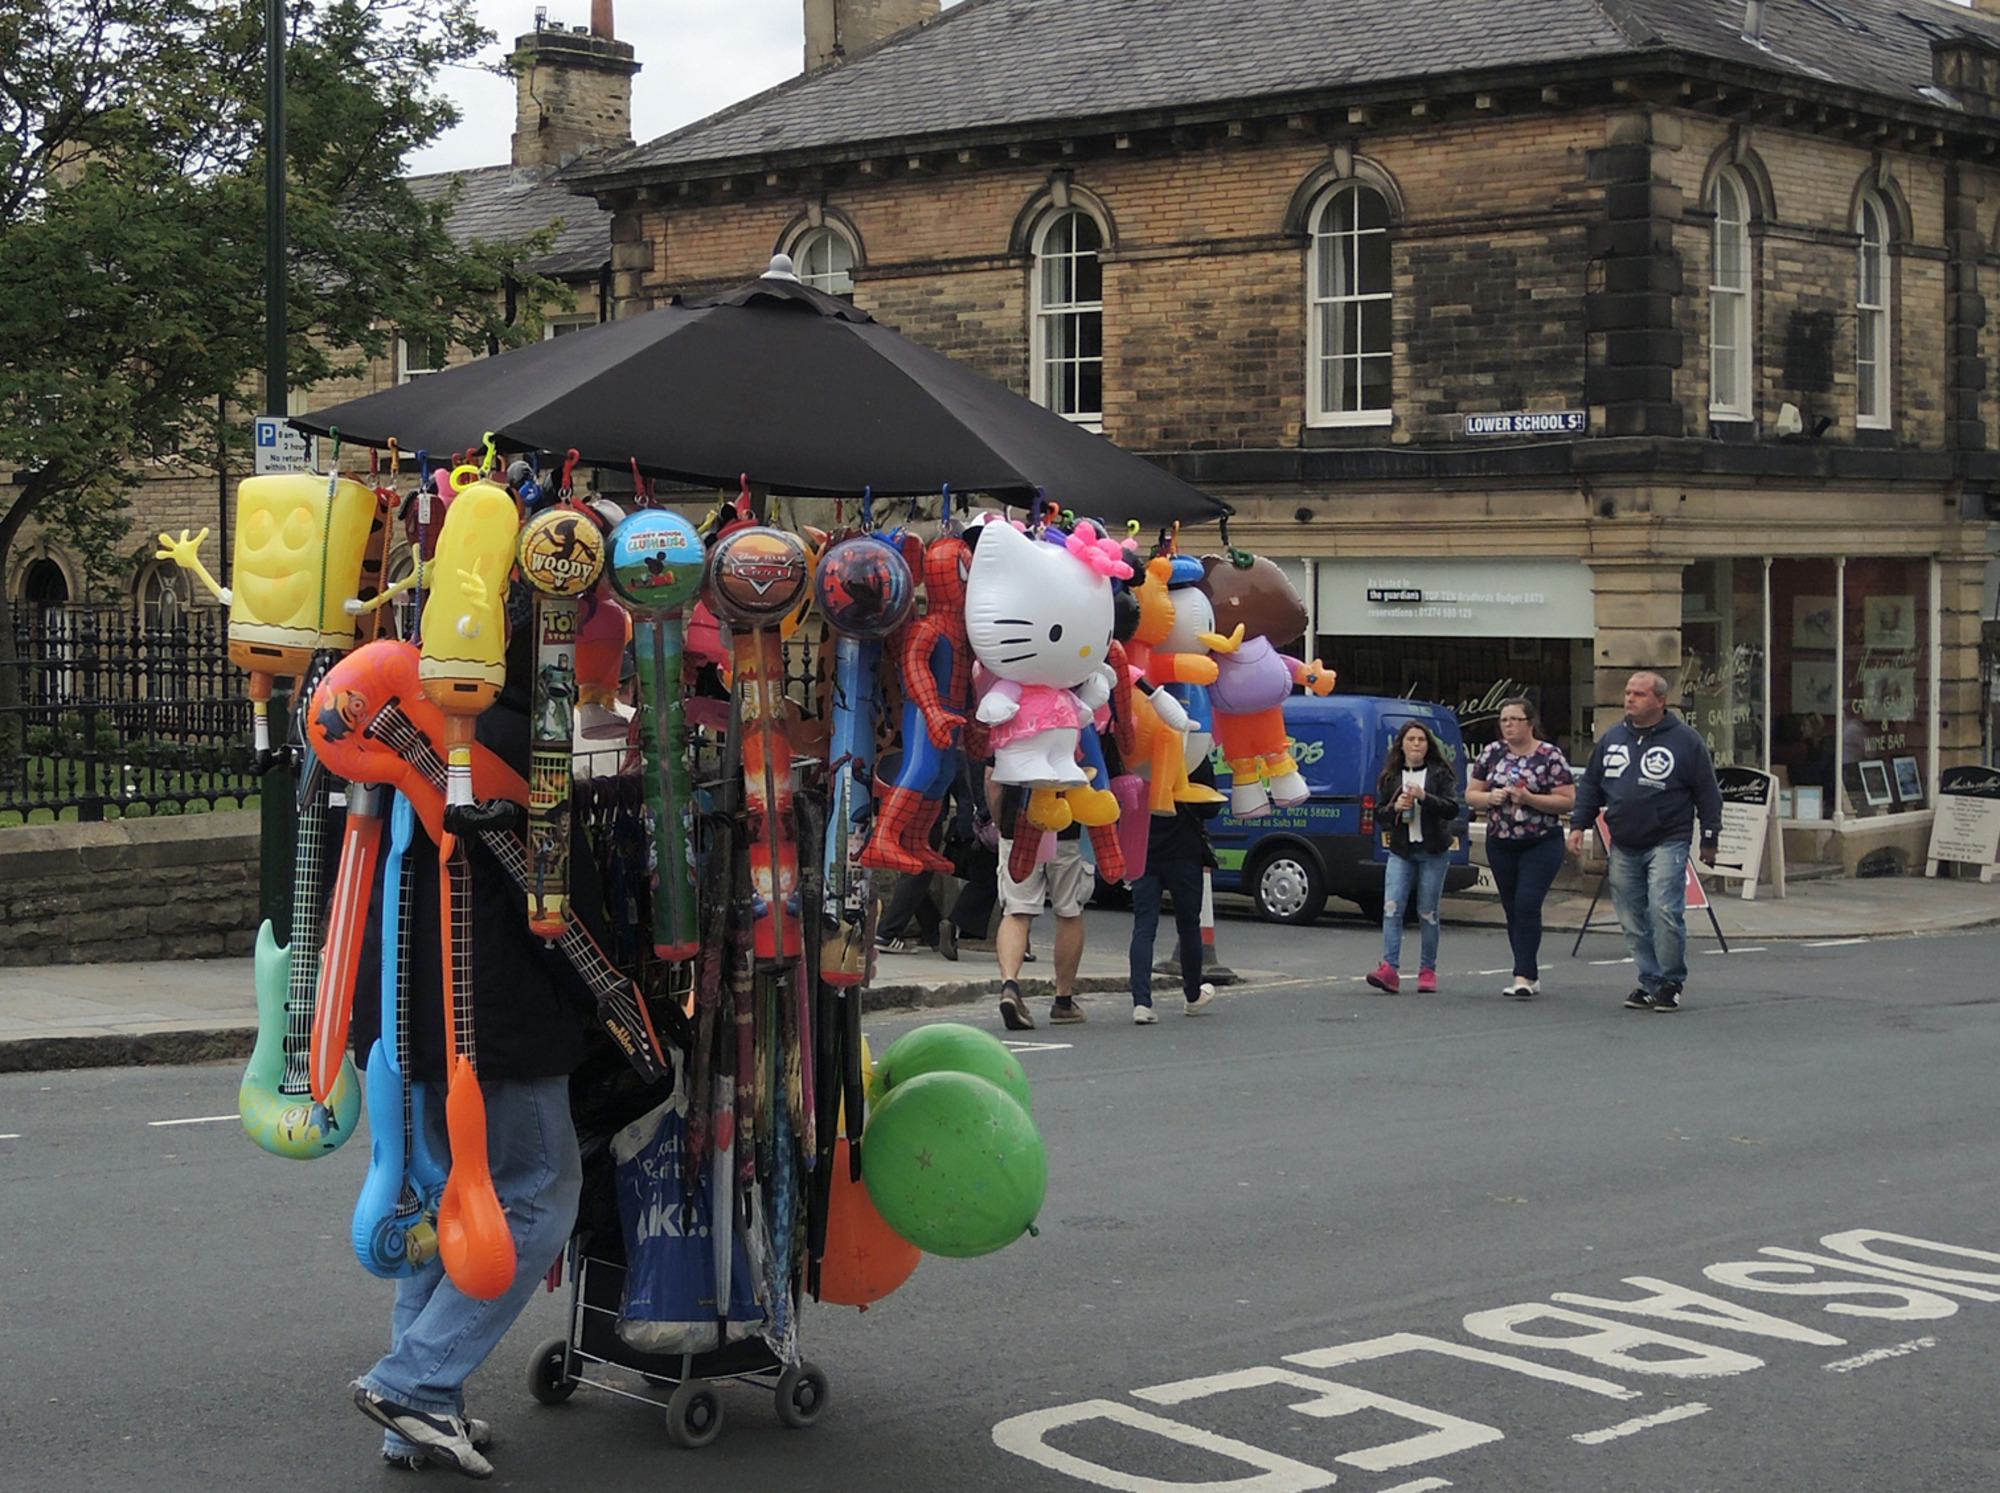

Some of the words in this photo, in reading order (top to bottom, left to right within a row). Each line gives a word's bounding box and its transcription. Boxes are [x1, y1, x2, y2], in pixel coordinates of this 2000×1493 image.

[1468, 417, 1511, 432] LOWER
[1514, 414, 1565, 430] SCHOOL
[270, 454, 280, 462] No
[282, 454, 303, 462] return
[265, 463, 286, 471] within
[628, 536, 686, 550] CLUBHOUSE
[532, 553, 593, 584] WOODY
[1369, 590, 1382, 599] the
[1368, 608, 1413, 617] reservations
[1708, 707, 1751, 726] GALLERY
[1864, 735, 1885, 752] WINE
[1887, 733, 1906, 749] BAR
[1287, 806, 1308, 816] 01274
[605, 1019, 636, 1056] minions
